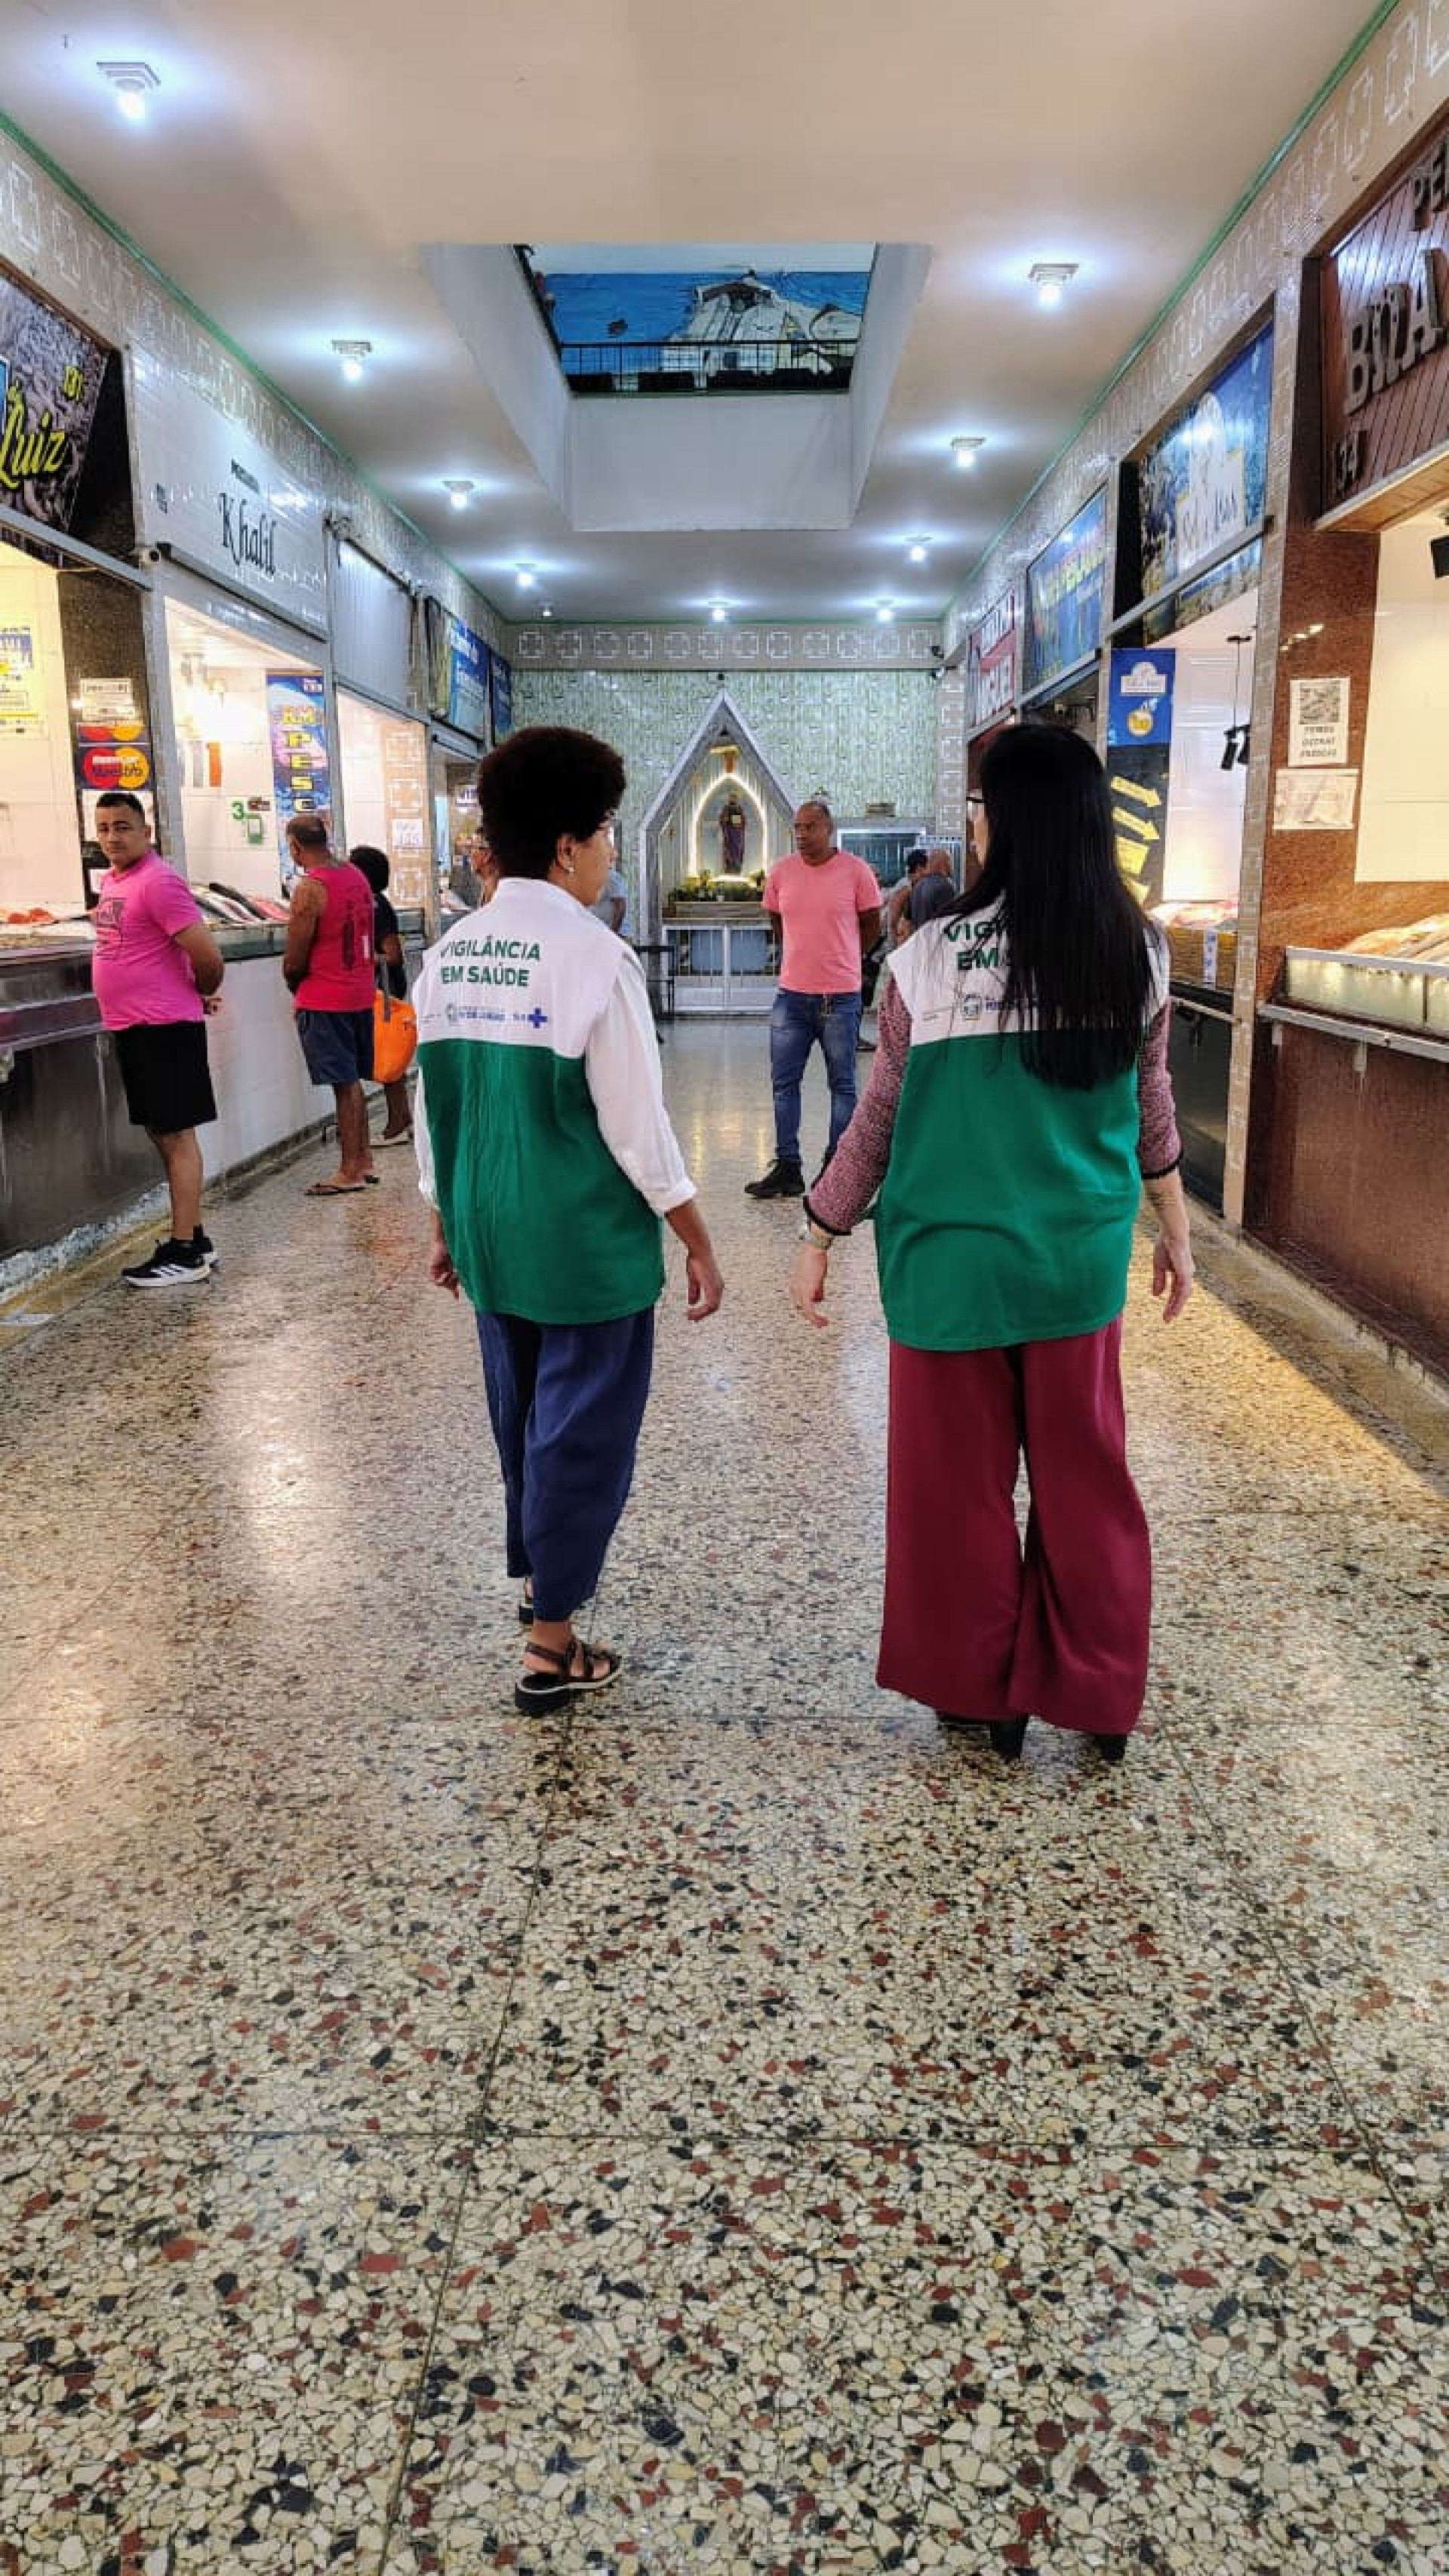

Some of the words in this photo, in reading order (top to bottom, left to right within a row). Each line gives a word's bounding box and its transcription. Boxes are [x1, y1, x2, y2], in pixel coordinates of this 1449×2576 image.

[219, 492, 277, 576] Khalil
[441, 965, 463, 984] EM
[466, 962, 530, 986] SAÚDE
